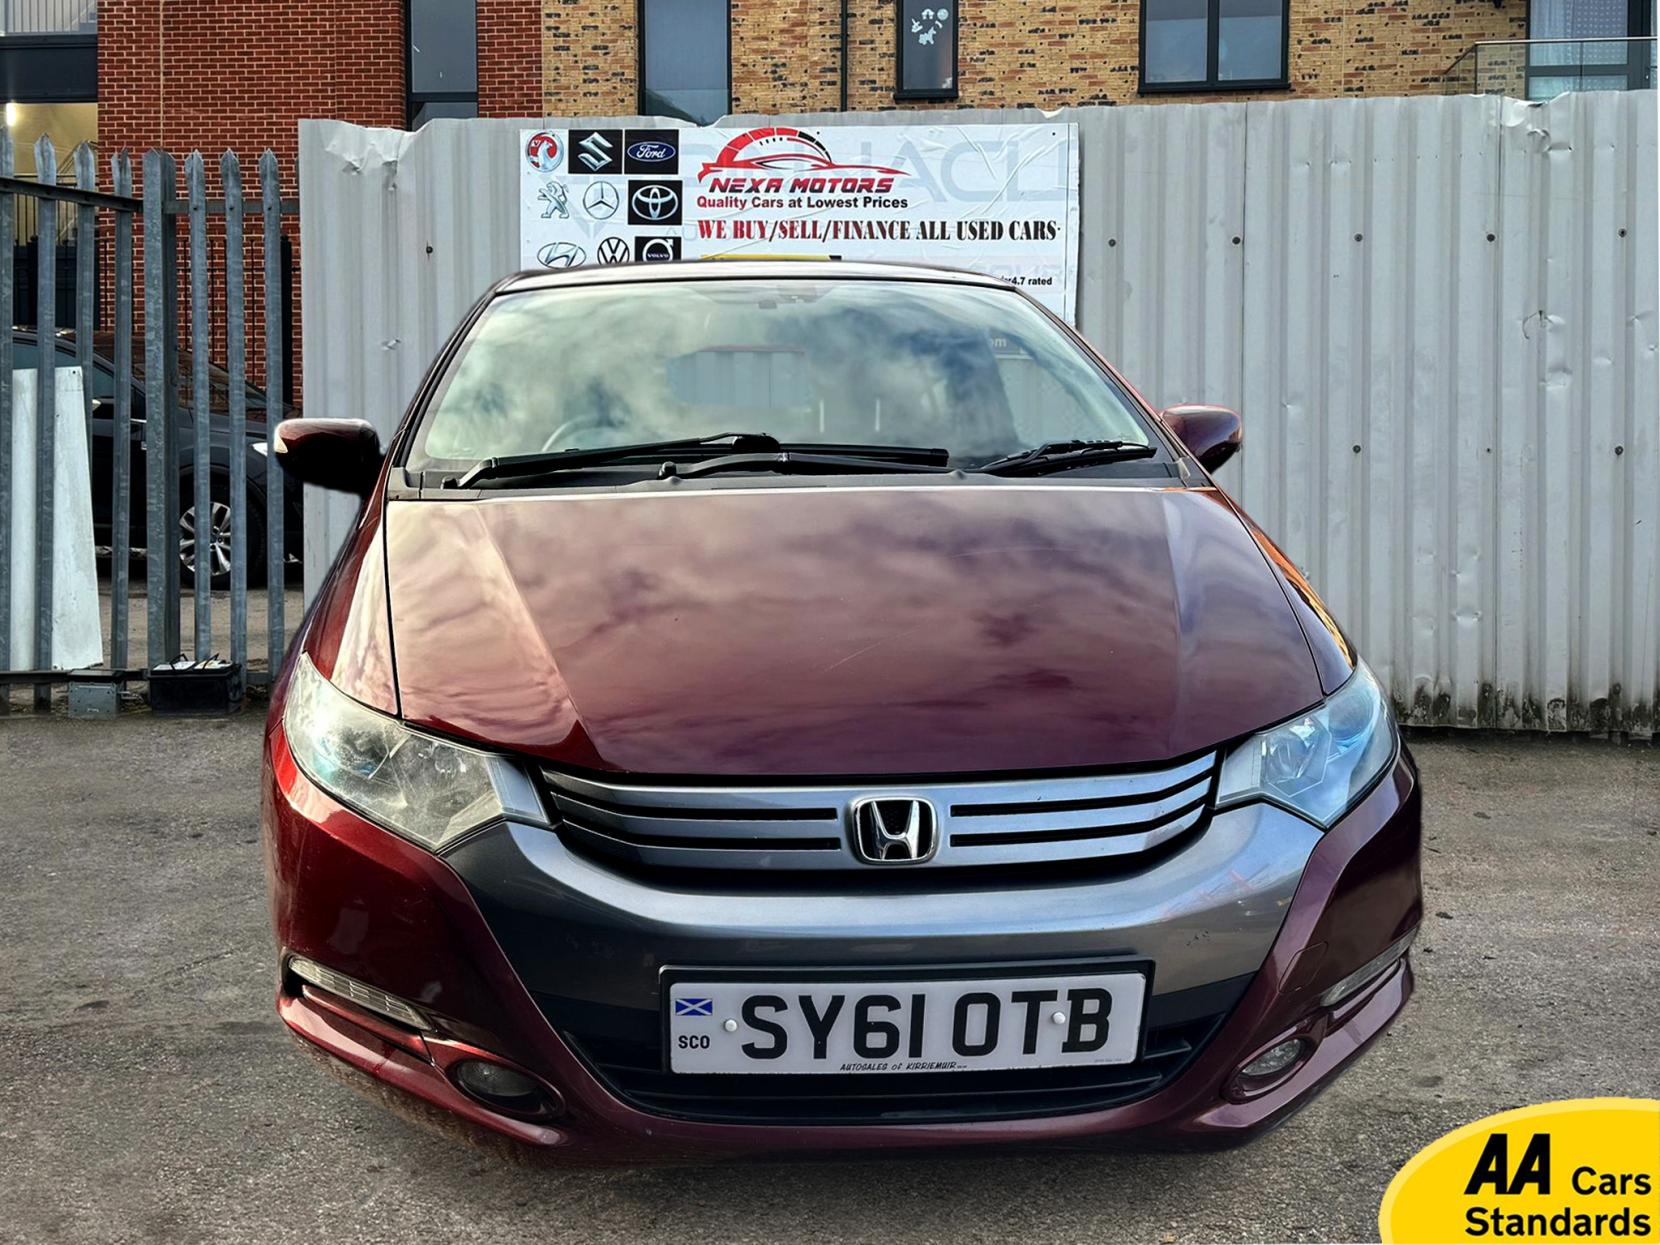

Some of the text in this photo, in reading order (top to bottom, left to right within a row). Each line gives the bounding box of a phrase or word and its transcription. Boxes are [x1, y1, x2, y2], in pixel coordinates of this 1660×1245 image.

[636, 144, 666, 159] Ford
[708, 177, 895, 194] NEXA MOTORS
[696, 196, 909, 211] Quality Cars at Lowest Prices
[697, 220, 727, 241] WE
[732, 219, 911, 243] BUY/SELL/FINANCE
[915, 220, 951, 241] ALL
[956, 220, 1004, 241] USED
[1008, 219, 1057, 241] CARS
[1027, 276, 1053, 286] rated
[740, 987, 1113, 1060] SY61 OTB
[678, 1035, 711, 1050] SCO
[839, 1062, 888, 1072] AUTOSALES
[905, 1061, 958, 1071] KIRRIEMUIR
